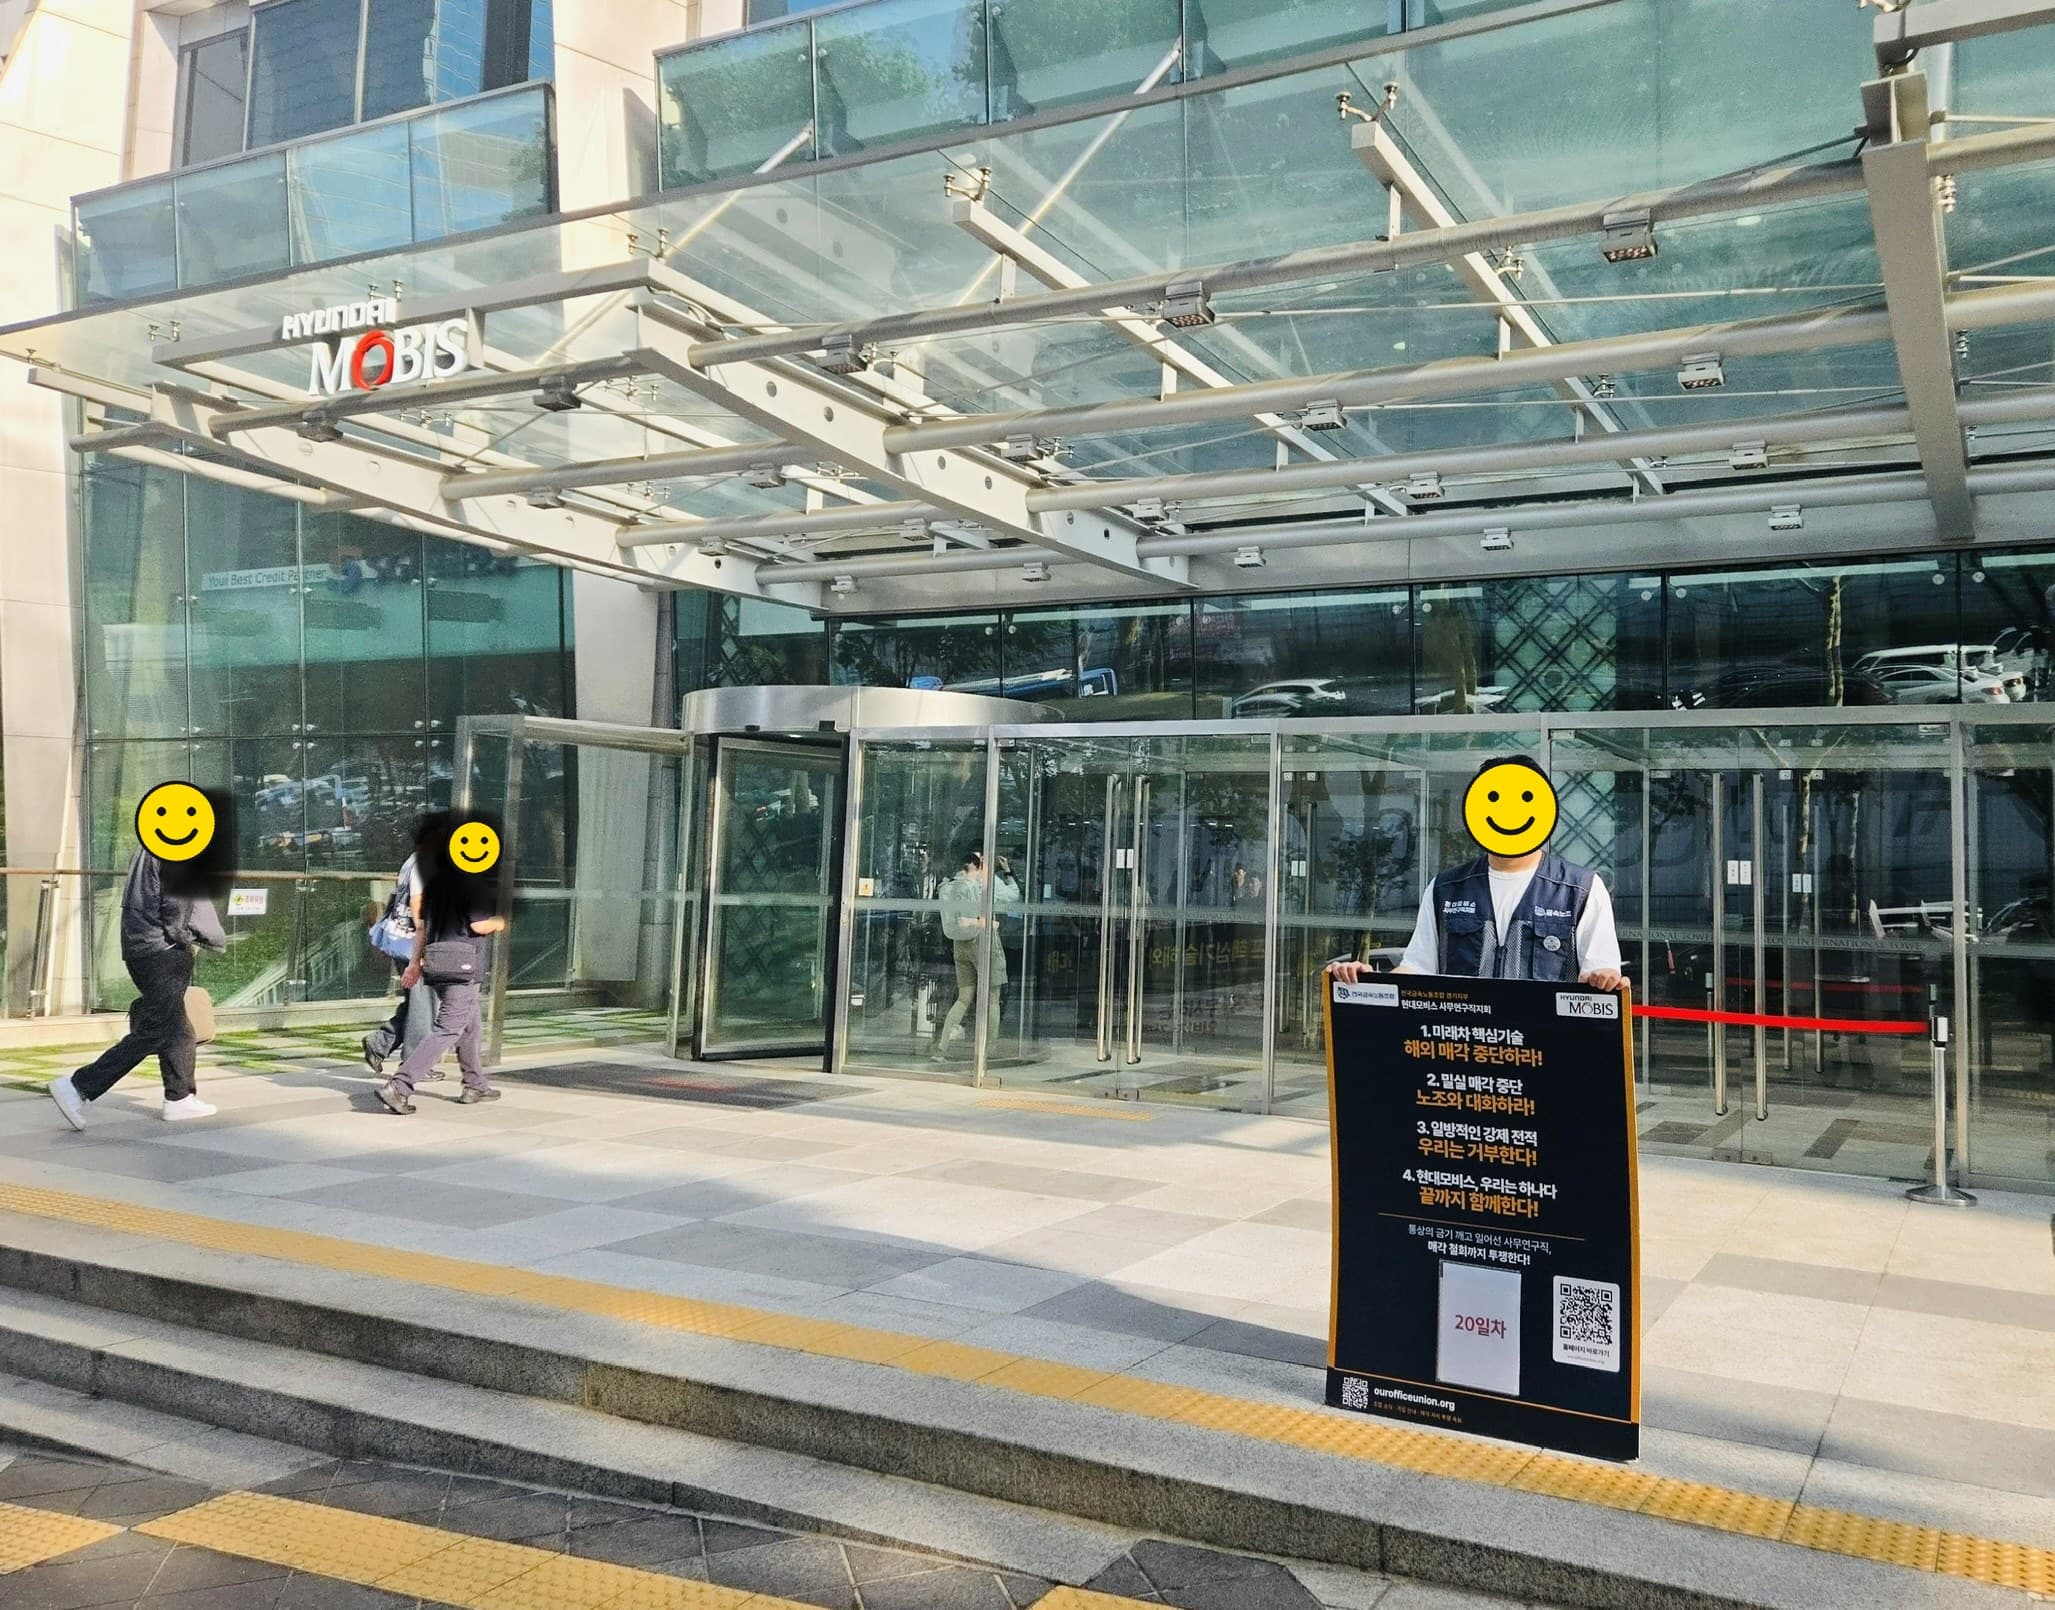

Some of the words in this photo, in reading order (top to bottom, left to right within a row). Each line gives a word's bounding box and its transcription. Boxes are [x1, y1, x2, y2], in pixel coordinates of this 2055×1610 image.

[282, 298, 399, 340] HYUNDAI
[308, 318, 469, 396] MOBIS
[231, 573, 253, 586] Best
[255, 570, 286, 584] Credit
[288, 569, 327, 582] Patner
[1401, 1000, 1438, 1010] 현대모비스
[1439, 1001, 1492, 1014] 사무연구직지회
[1560, 994, 1593, 1002] HYUNDAI
[1569, 1001, 1614, 1016] MOBIS
[1420, 1024, 1432, 1038] 1.
[1432, 1025, 1471, 1042] 미래차
[1471, 1027, 1525, 1046] 핵심기술
[1404, 1040, 1436, 1060] 해외
[1438, 1042, 1471, 1062] 매각
[1472, 1044, 1543, 1067] 중단하라!
[1426, 1073, 1440, 1087] 2.
[1440, 1073, 1468, 1091] 밀실
[1468, 1075, 1495, 1093] 매각
[1496, 1078, 1524, 1095] 중단
[1416, 1088, 1464, 1110] 노조와
[1465, 1093, 1536, 1117] 대화하라!
[1416, 1120, 1430, 1135] 3.
[1430, 1121, 1482, 1141] 일방적인
[1482, 1127, 1510, 1145] 강제
[1510, 1129, 1539, 1147] 전적
[1418, 1137, 1465, 1160] 우리는
[1467, 1142, 1538, 1167] 거부한다!
[1402, 1168, 1416, 1182] 4.
[1416, 1168, 1479, 1192] 현대모비스,
[1480, 1176, 1518, 1195] 우리는
[1518, 1180, 1558, 1200] 하나다
[1419, 1186, 1466, 1211] 끝까지
[1468, 1191, 1540, 1218] 함께한다!
[1408, 1223, 1434, 1238] 통상의
[1435, 1227, 1454, 1241] 금기
[1455, 1230, 1474, 1242] 깨고
[1475, 1232, 1502, 1247] 일어선
[1503, 1236, 1552, 1256] 사무연구직,
[1427, 1241, 1447, 1255] 매각
[1449, 1243, 1487, 1260] 철회까지
[1488, 1249, 1531, 1266] 투쟁한다!
[1455, 1314, 1507, 1340] 20일차
[1586, 1346, 1610, 1358] 바로가기
[1373, 1387, 1456, 1411] ourofficeunion.org
